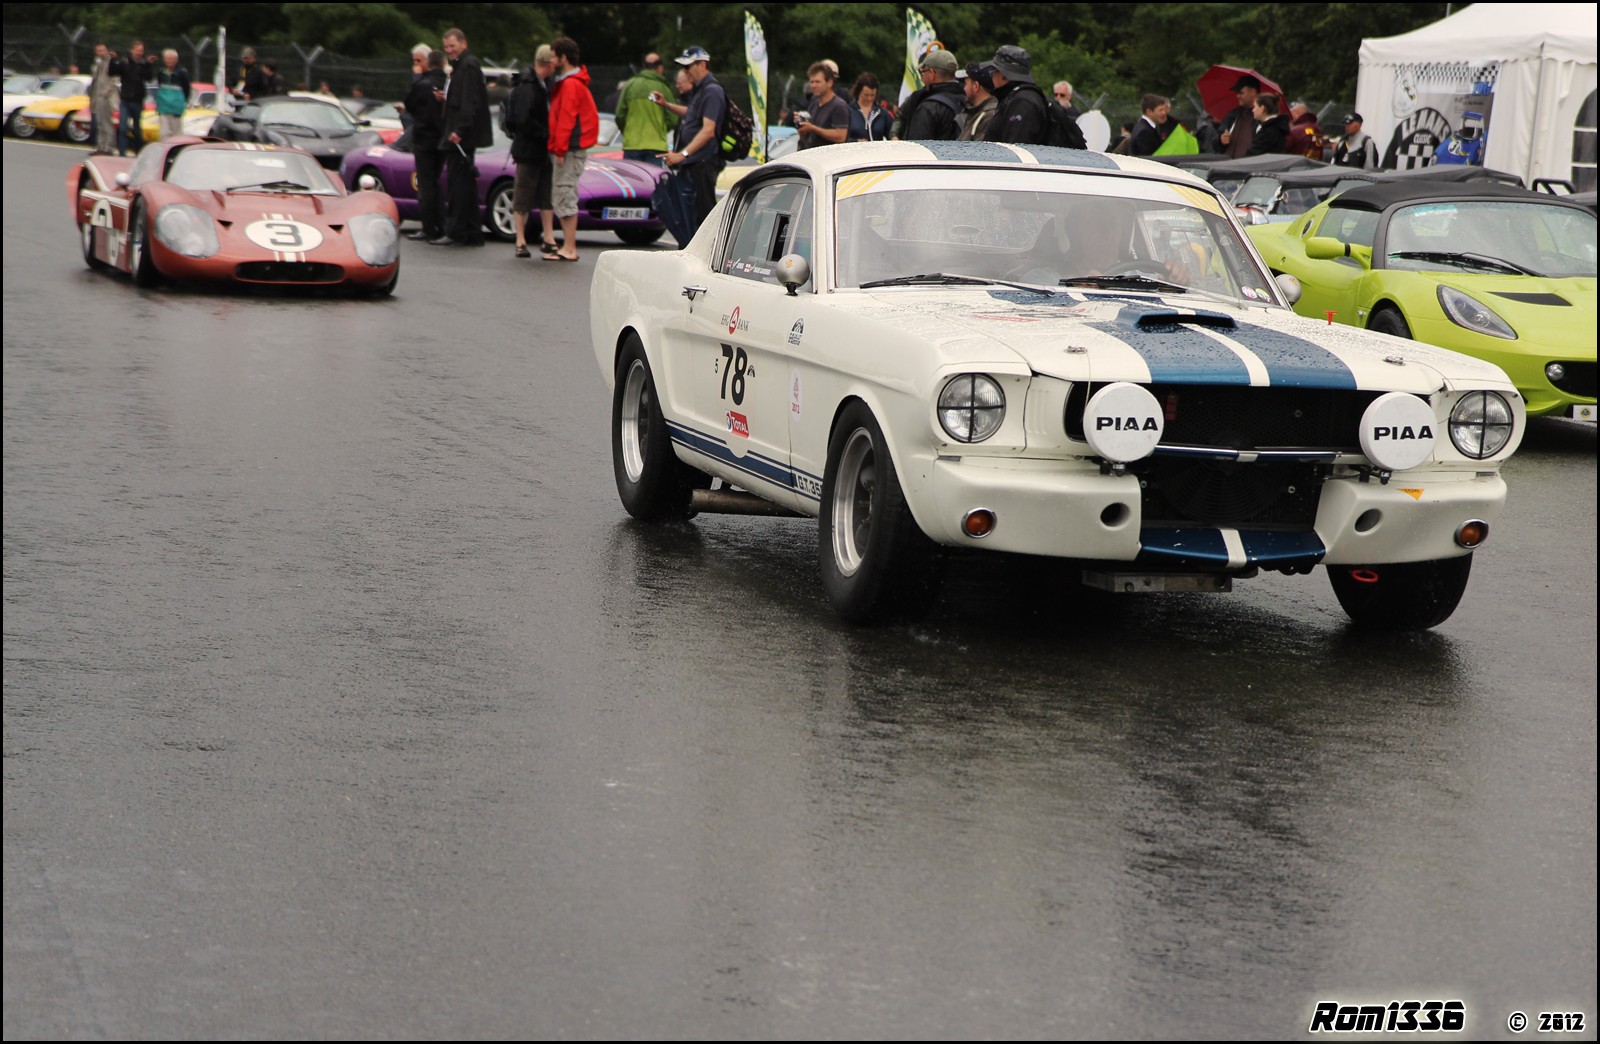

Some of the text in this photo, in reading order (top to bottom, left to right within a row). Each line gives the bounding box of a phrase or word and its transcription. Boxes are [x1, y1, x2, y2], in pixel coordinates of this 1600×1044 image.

[265, 222, 304, 247] 3
[737, 317, 751, 332] BANK
[714, 358, 719, 374] 5
[720, 343, 748, 406] 78
[731, 415, 750, 434] TOTAL
[1096, 416, 1159, 431] PIAA
[1373, 425, 1434, 441] PIAA
